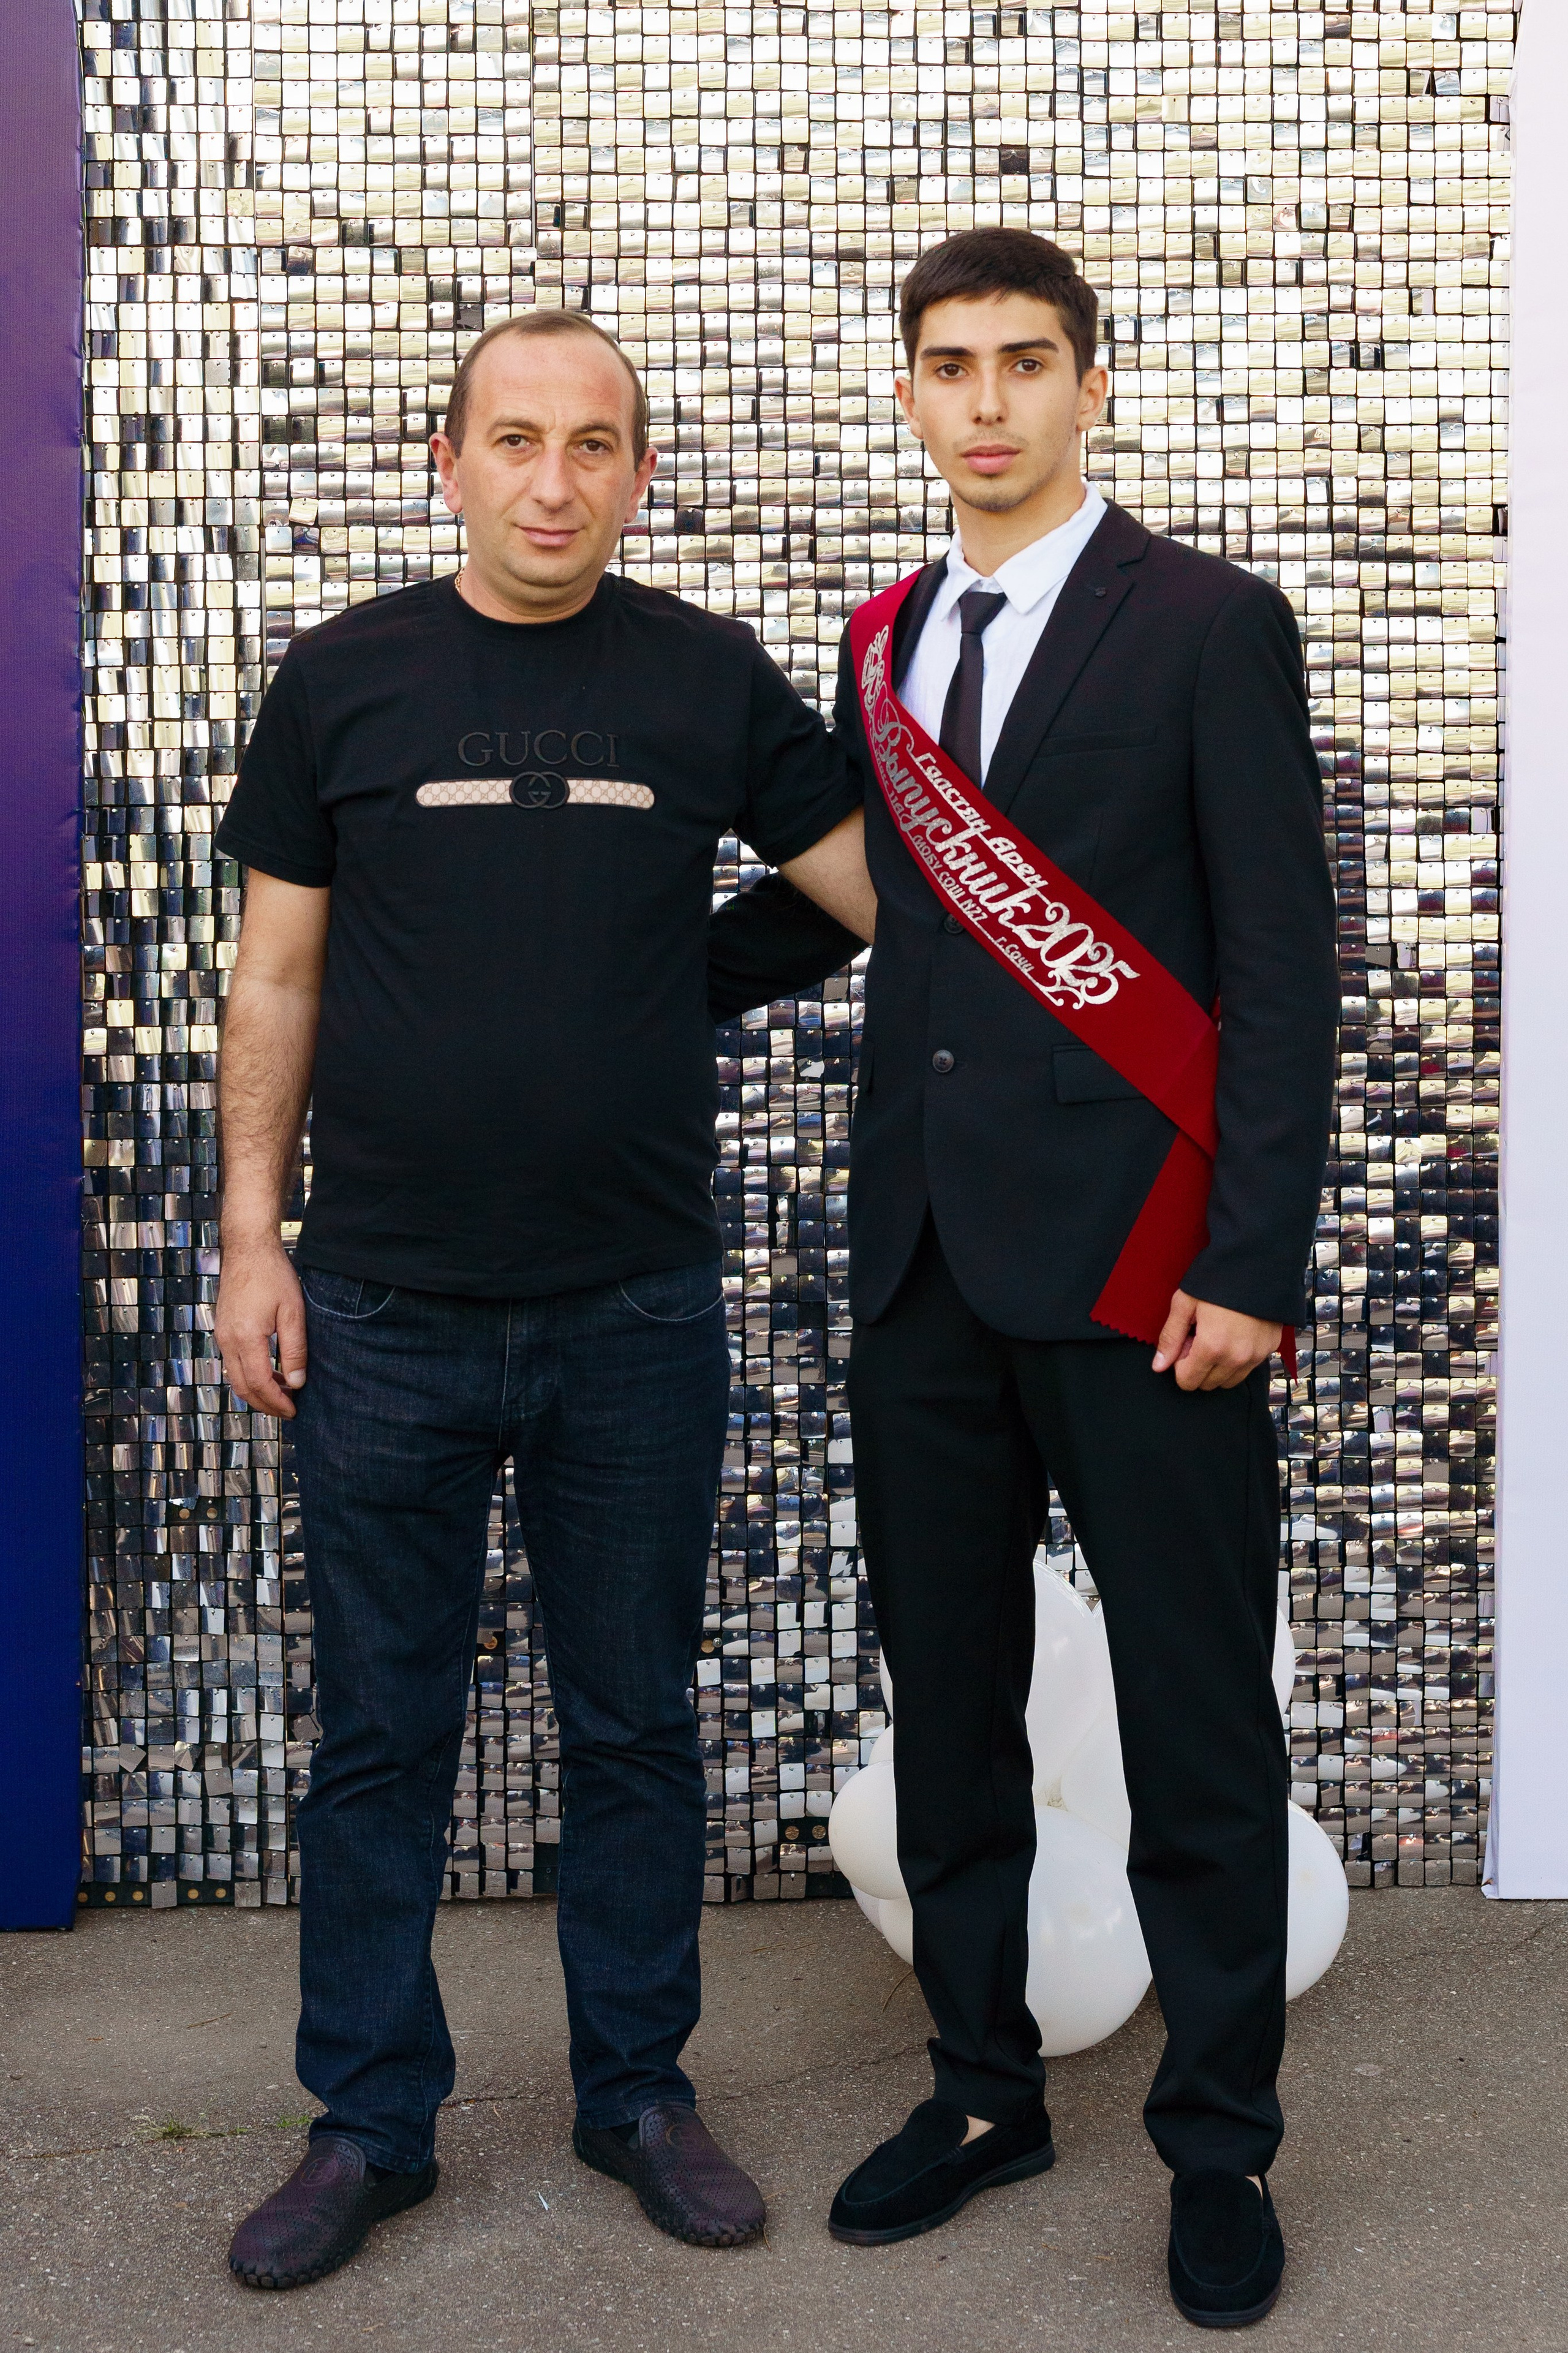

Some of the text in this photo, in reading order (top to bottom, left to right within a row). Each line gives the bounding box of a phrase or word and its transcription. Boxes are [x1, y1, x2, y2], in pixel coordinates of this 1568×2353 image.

[458, 730, 619, 767] GUCCI
[987, 836, 1048, 889] Арен
[938, 871, 966, 904] СОШ
[995, 936, 1035, 975] г.Сочи
[1014, 901, 1140, 1005] 2025
